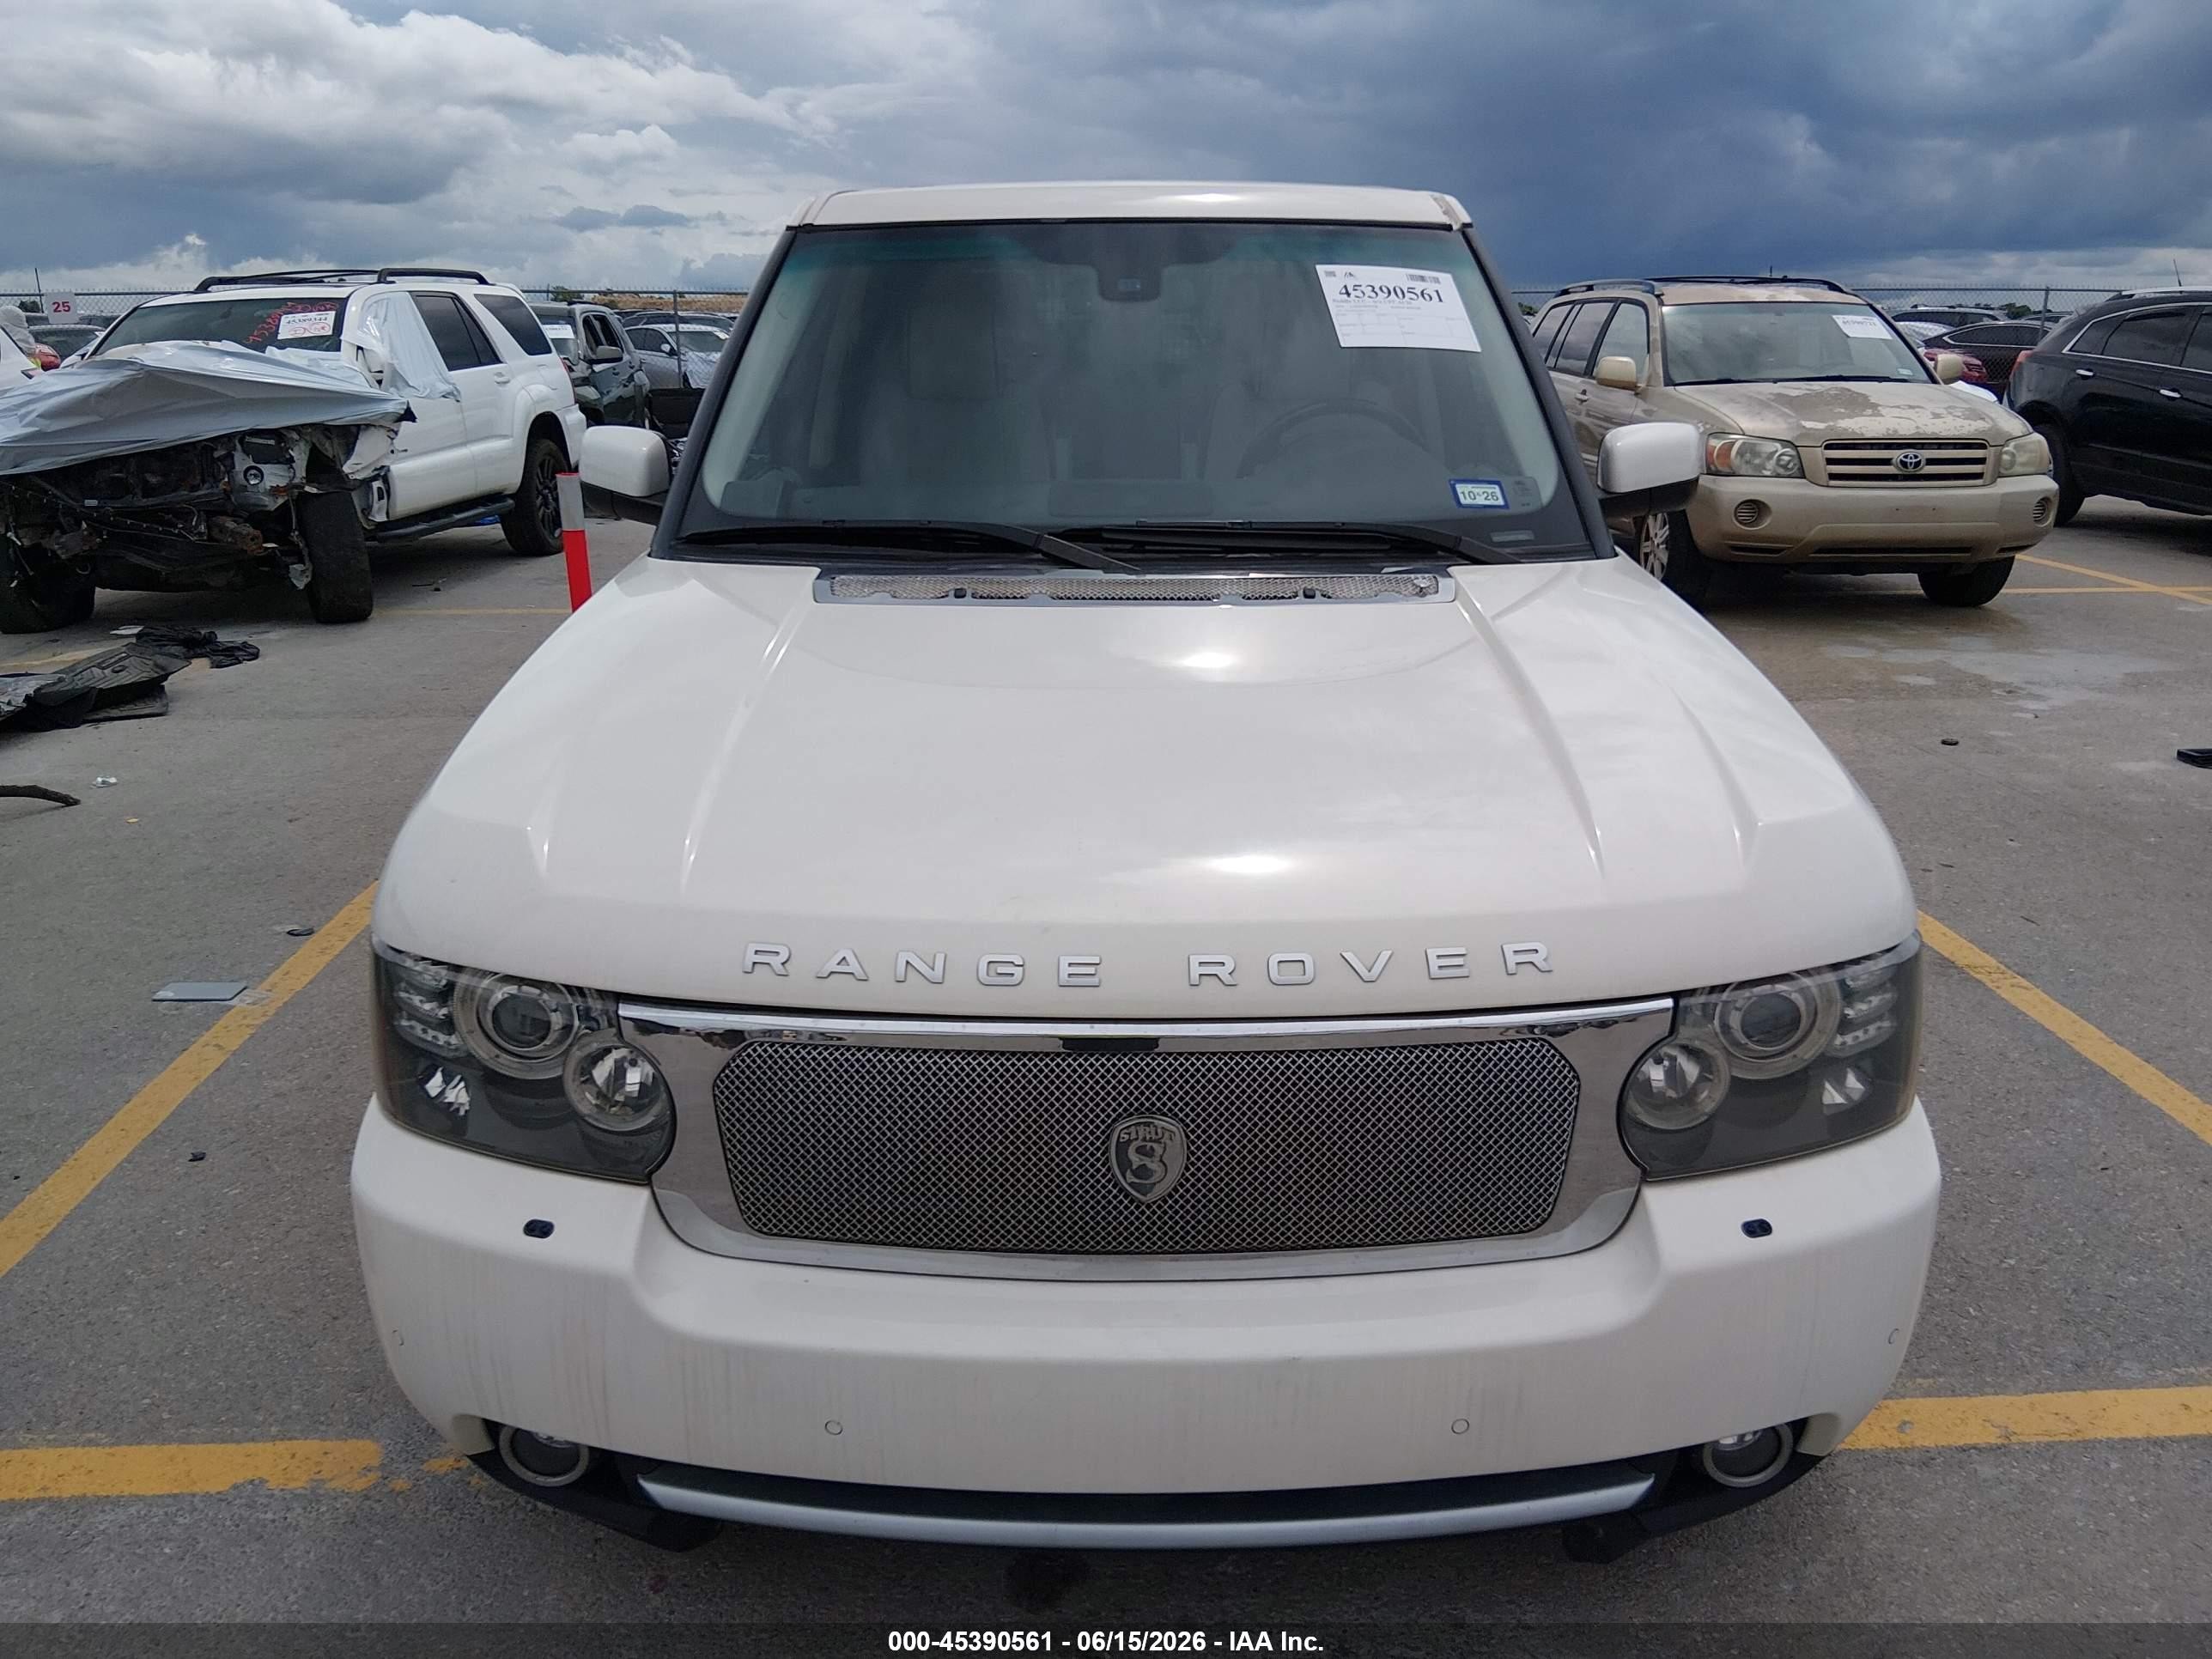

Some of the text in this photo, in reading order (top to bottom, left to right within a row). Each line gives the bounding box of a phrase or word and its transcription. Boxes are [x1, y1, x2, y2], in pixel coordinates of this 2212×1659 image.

[1339, 284, 1445, 304] 45390561
[52, 301, 71, 313] 25
[742, 939, 1555, 988] RANGE ROVER
